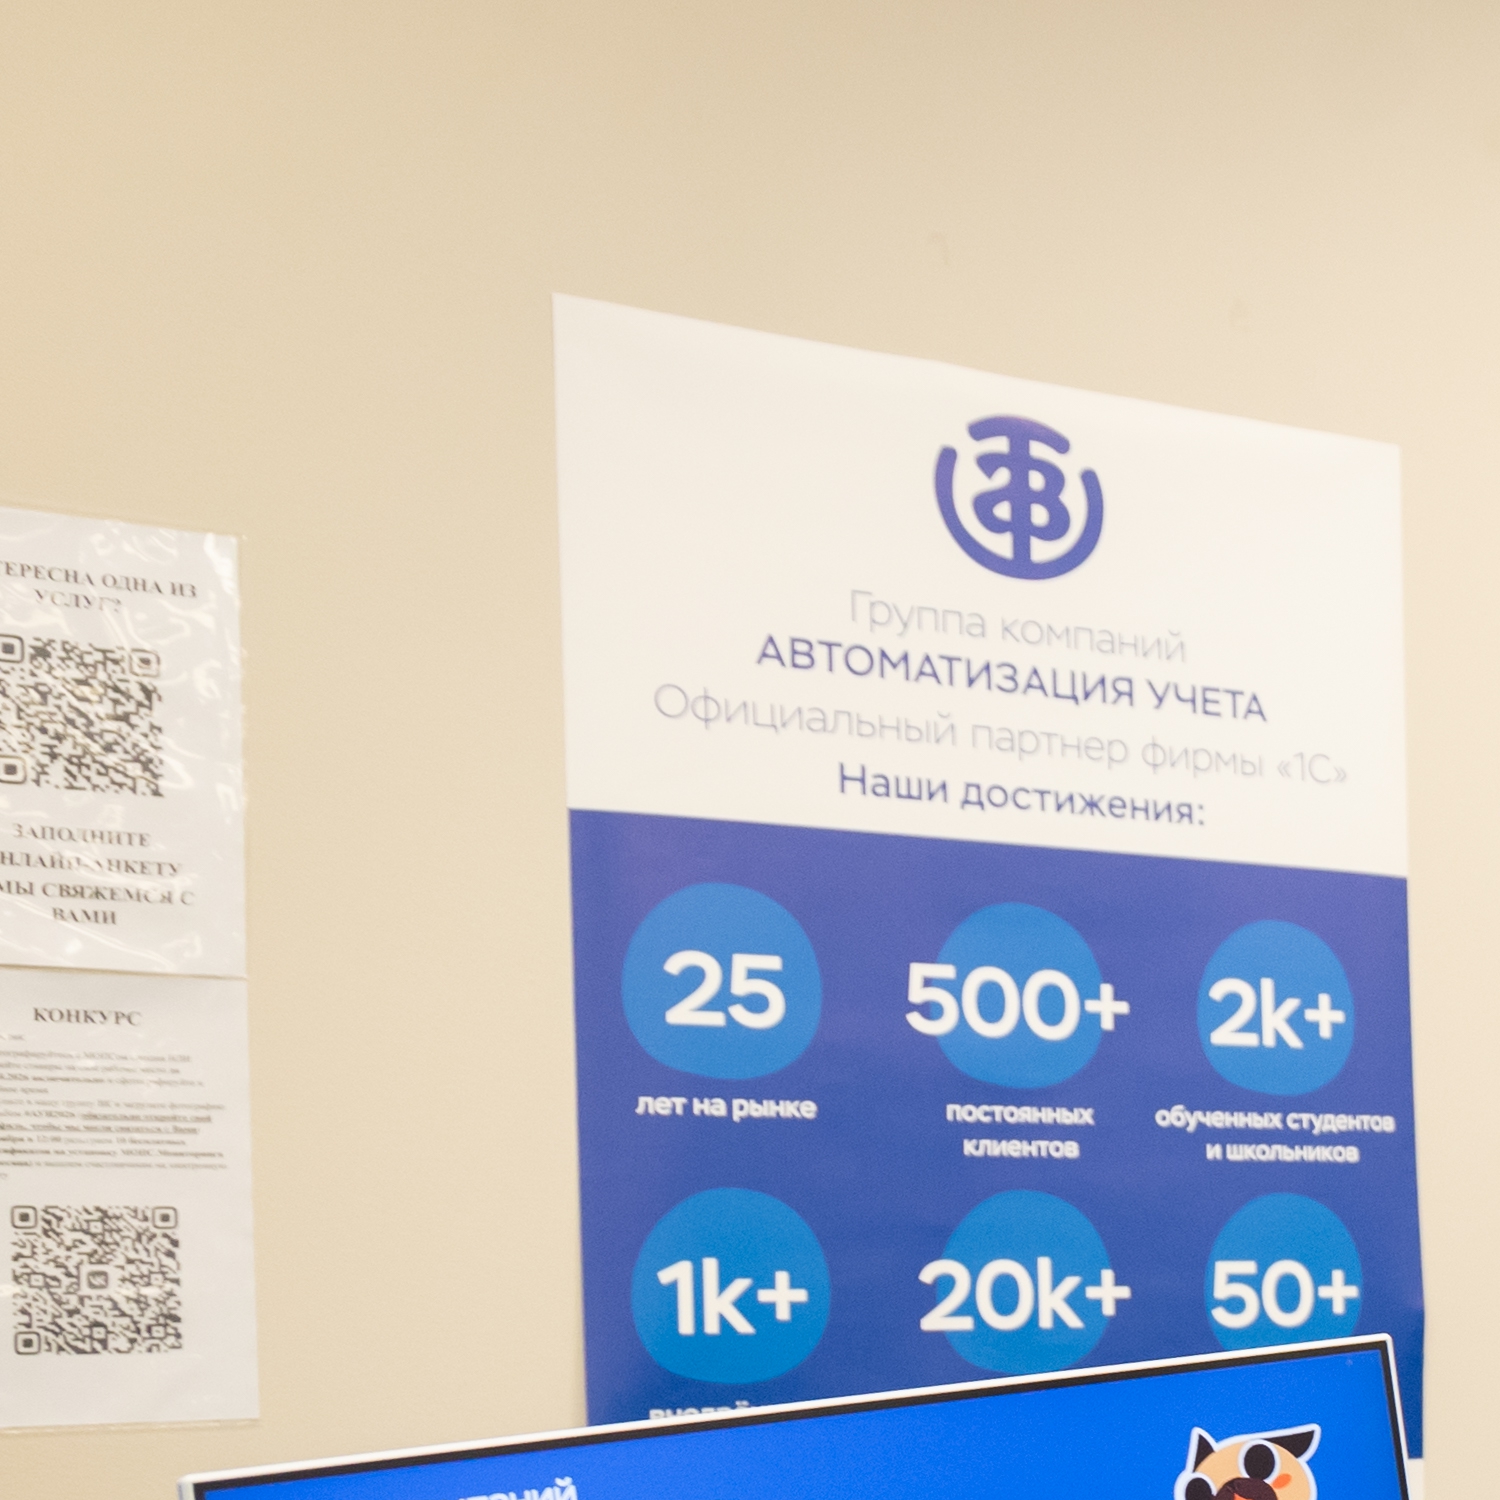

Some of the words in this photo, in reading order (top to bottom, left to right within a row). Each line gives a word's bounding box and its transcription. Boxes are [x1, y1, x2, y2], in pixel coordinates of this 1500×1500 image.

[102, 573, 163, 593] ОДНА
[169, 581, 197, 598] ИЗ
[849, 588, 987, 640] Группа
[1000, 611, 1187, 664] компаний
[755, 633, 1135, 711] АВТОМАТИЗАЦИЯ
[1146, 677, 1268, 723] УЧЕТА
[654, 682, 957, 747] Официальный
[970, 721, 1130, 774] партнер
[1141, 733, 1264, 782] фирмы
[838, 761, 949, 806] Наши
[962, 779, 1205, 828] достижения:
[52, 907, 117, 925] ВАМИ
[662, 950, 787, 1031] 25
[905, 962, 1131, 1042] 500+
[33, 1007, 142, 1027] КОНКУРС
[635, 1091, 686, 1118] лет
[692, 1095, 726, 1118] на
[731, 1096, 818, 1124] рынке
[945, 1101, 1095, 1128] постоянных
[1154, 1107, 1283, 1133] обученных
[1286, 1110, 1396, 1138] студентов
[962, 1134, 1080, 1160] клиентов
[1205, 1142, 1222, 1160] и
[1226, 1140, 1360, 1164] школьников
[1210, 1260, 1360, 1329] 50+
